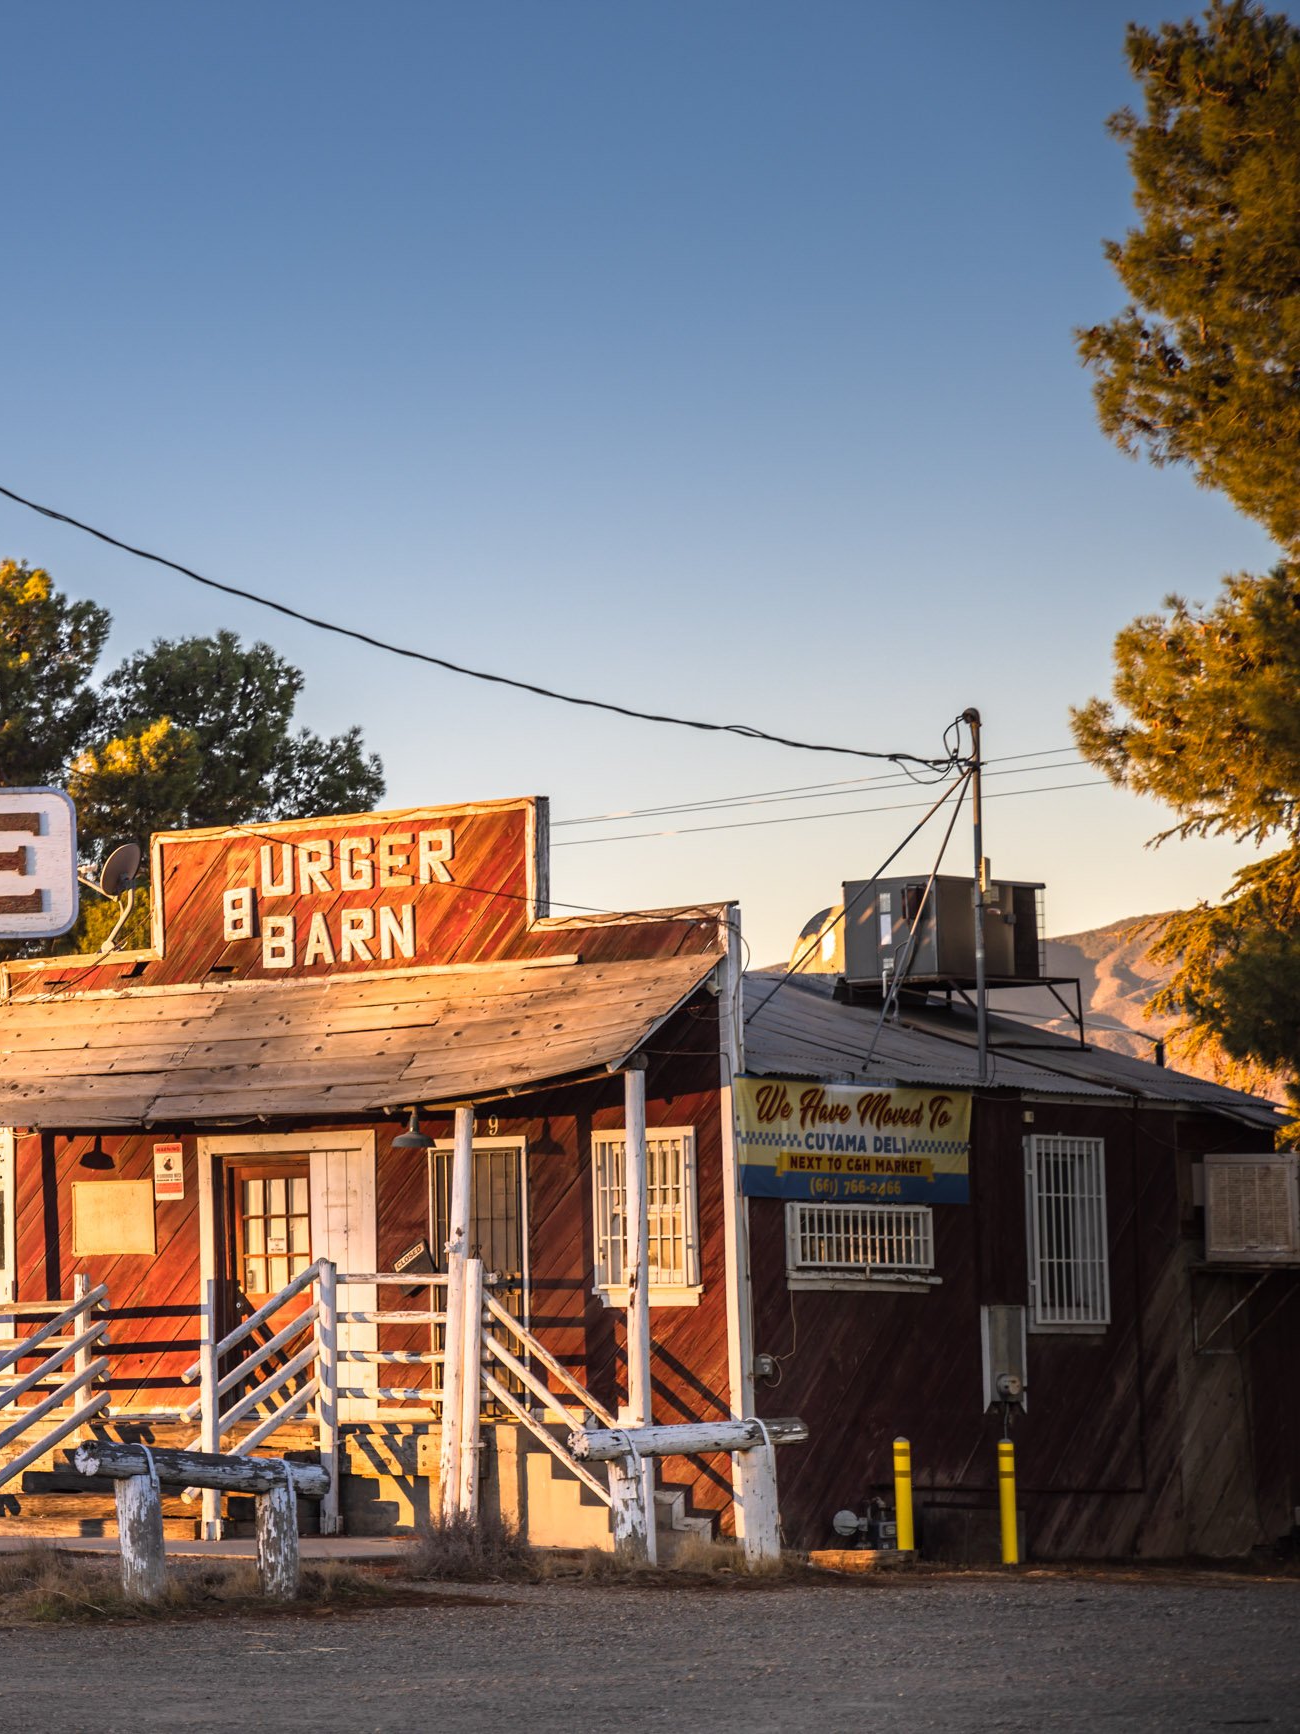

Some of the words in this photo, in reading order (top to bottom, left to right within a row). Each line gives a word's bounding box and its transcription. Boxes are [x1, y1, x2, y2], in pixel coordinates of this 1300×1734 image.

[262, 904, 416, 969] BARN
[756, 1085, 793, 1124] We
[799, 1087, 851, 1131] Have
[857, 1093, 924, 1132] Moved
[929, 1095, 953, 1134] To
[804, 1132, 867, 1152] CUYAMA
[873, 1135, 906, 1154] DELI
[790, 1156, 822, 1170] NEXT
[827, 1157, 842, 1171] TO
[846, 1158, 871, 1172] C&H
[875, 1160, 922, 1174] MARKET
[810, 1177, 838, 1196] (661)
[396, 1245, 422, 1269] CLOSED
